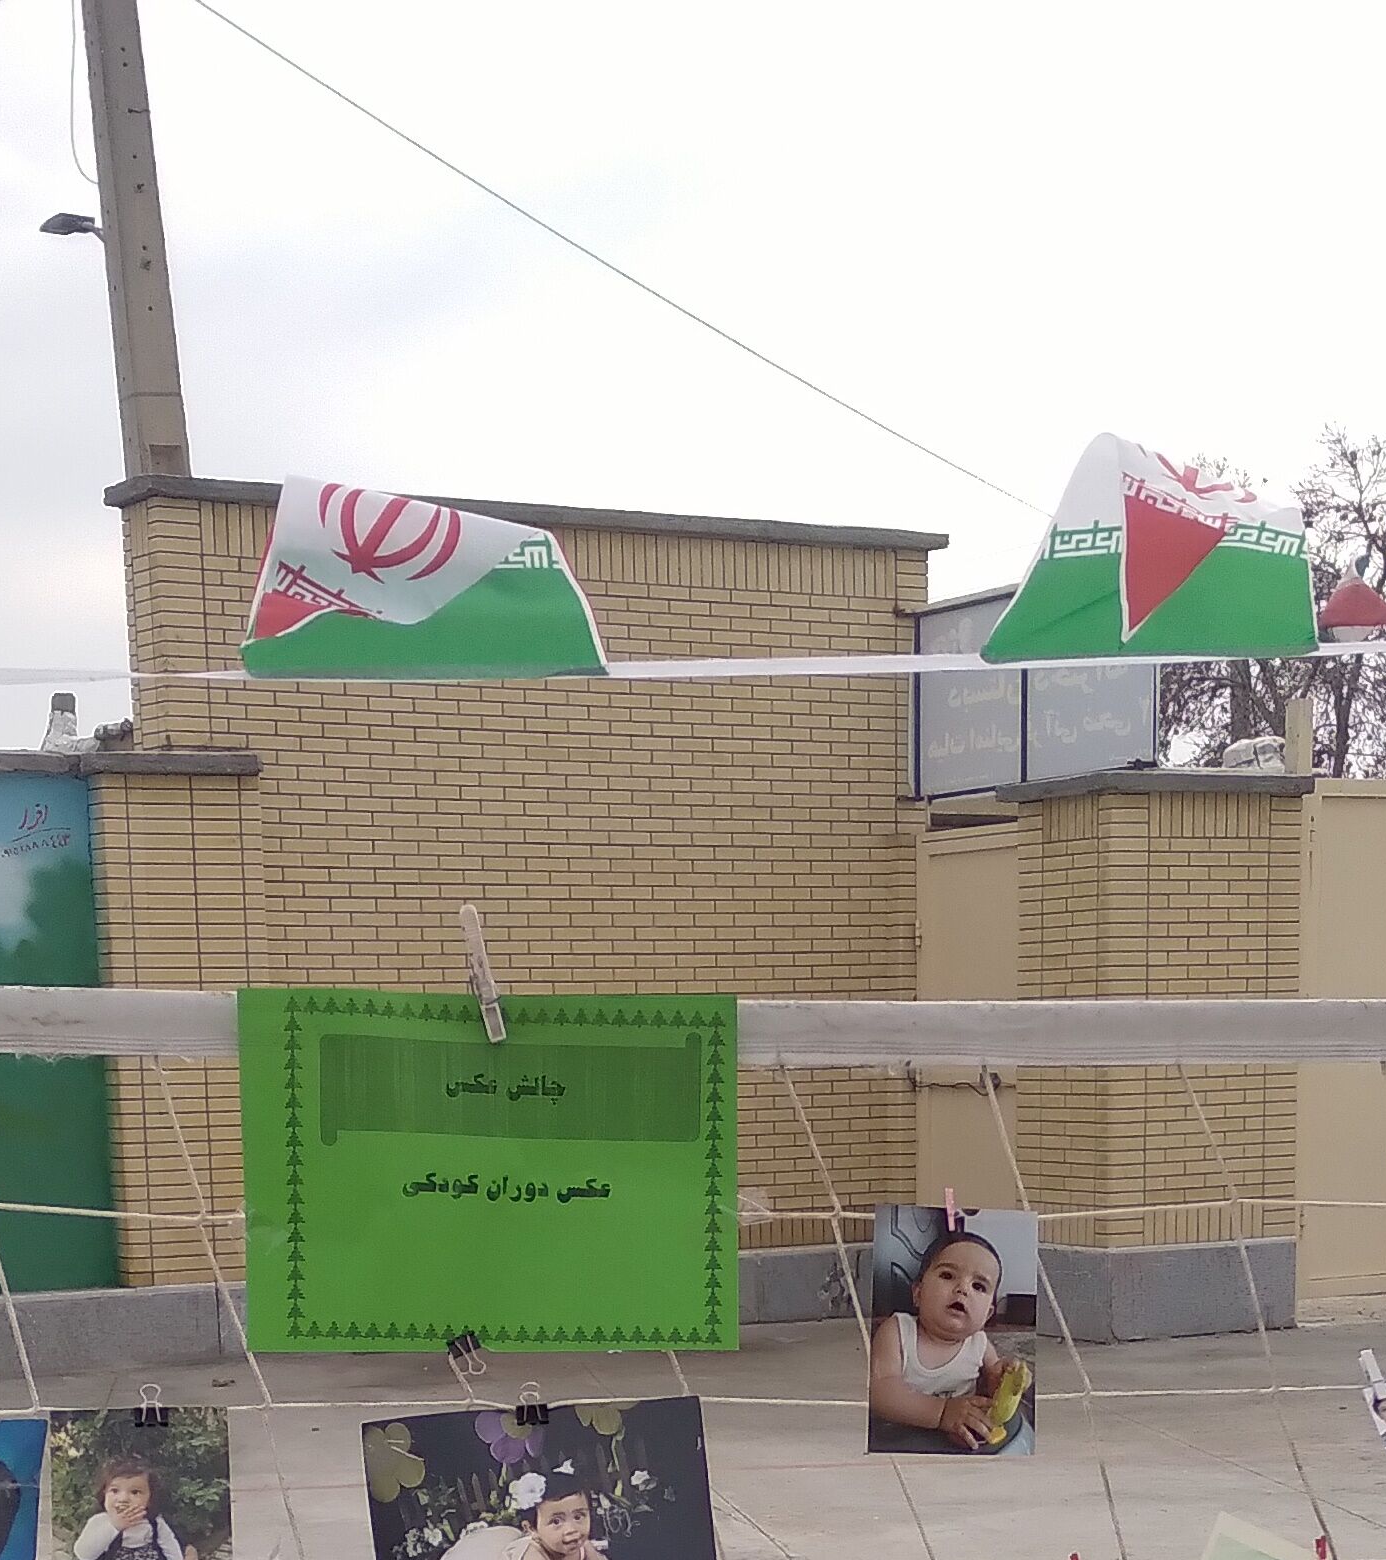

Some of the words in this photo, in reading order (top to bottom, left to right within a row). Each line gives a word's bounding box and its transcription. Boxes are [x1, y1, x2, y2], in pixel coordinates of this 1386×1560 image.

[445, 1073, 498, 1099] عکس
[505, 1074, 566, 1106] چالش
[401, 1172, 479, 1199] کودکی
[485, 1175, 549, 1203] دوران
[556, 1177, 612, 1205] عکس
